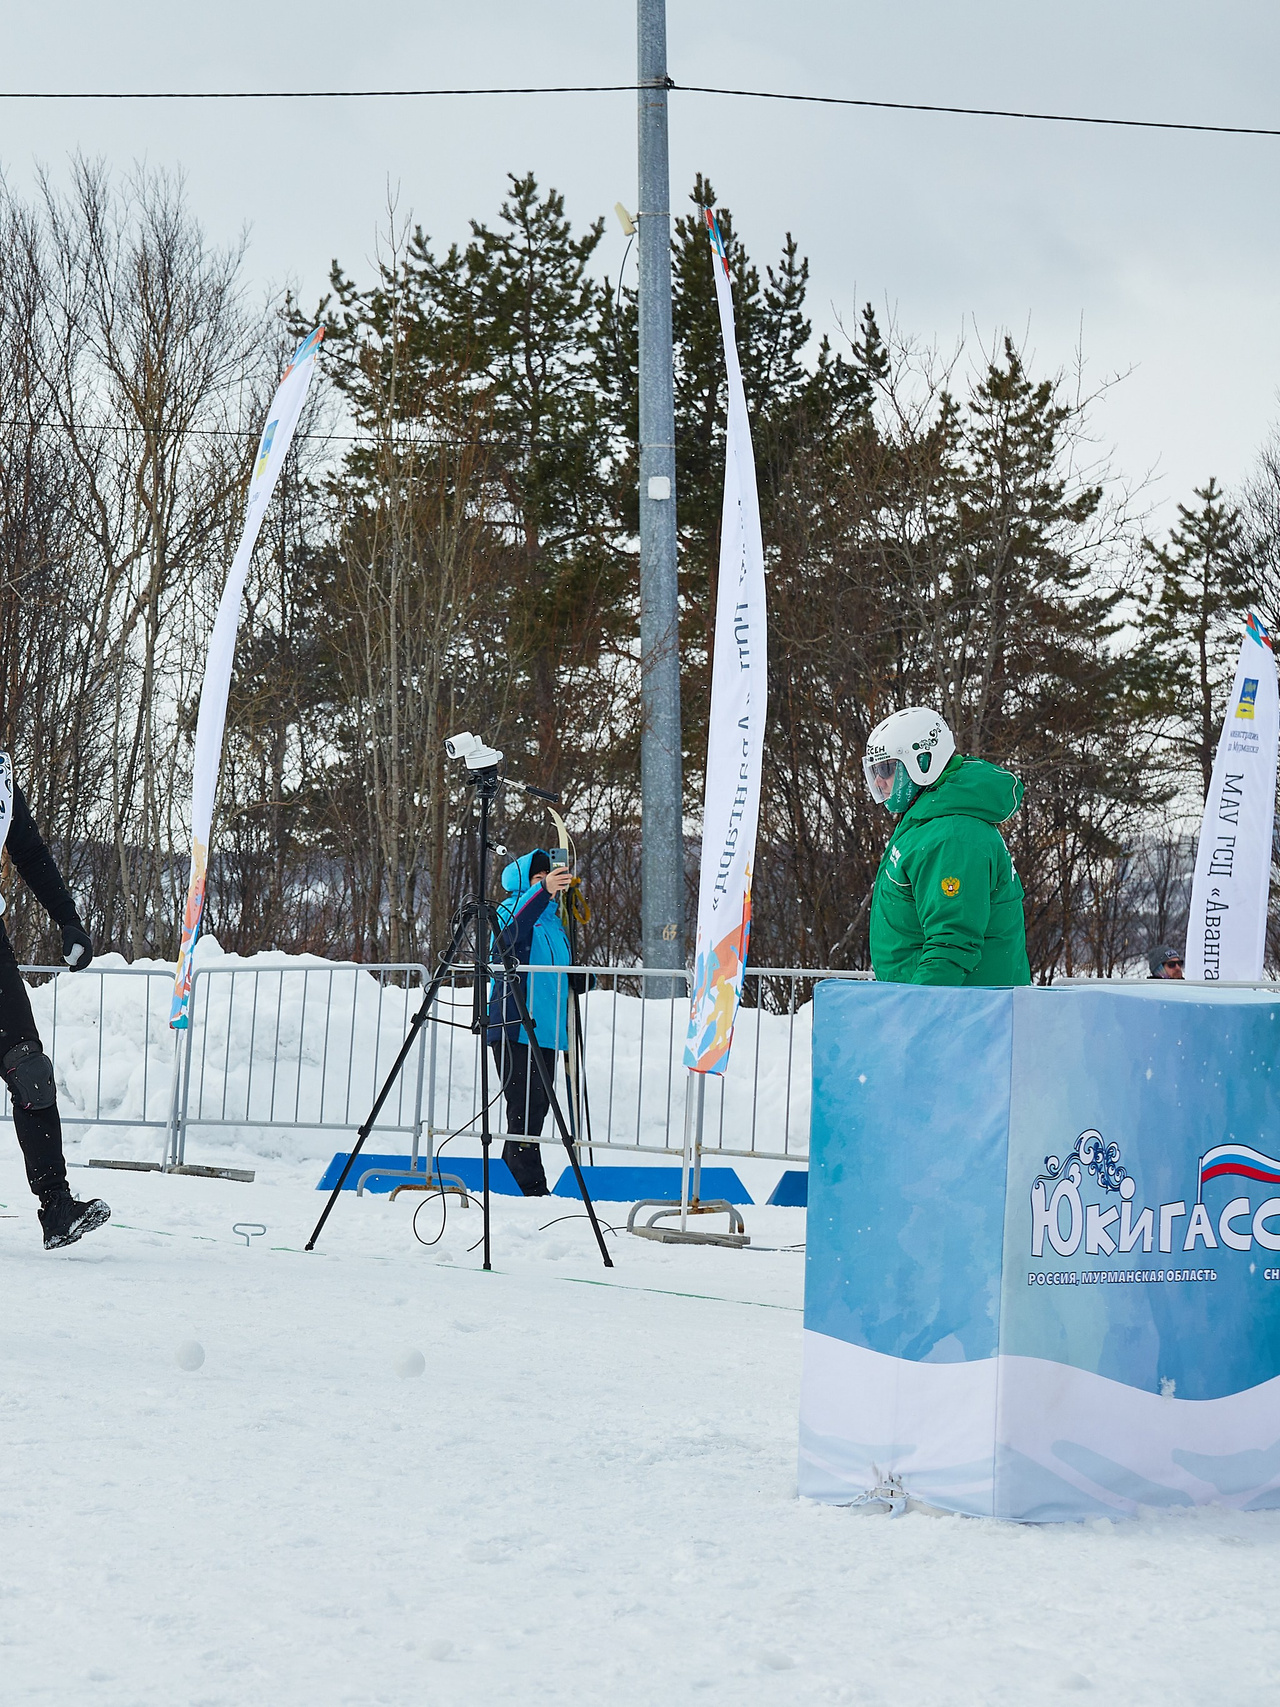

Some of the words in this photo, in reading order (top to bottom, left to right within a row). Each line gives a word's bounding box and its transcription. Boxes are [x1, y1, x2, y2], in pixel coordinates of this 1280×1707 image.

[1219, 773, 1245, 826] МАУ
[1207, 836, 1237, 879] ГСЦ
[1028, 1270, 1080, 1286] РОССИЯ,
[1081, 1269, 1165, 1285] МУРМАНСКАЯ
[1166, 1268, 1218, 1284] ОБЛАСТЬ
